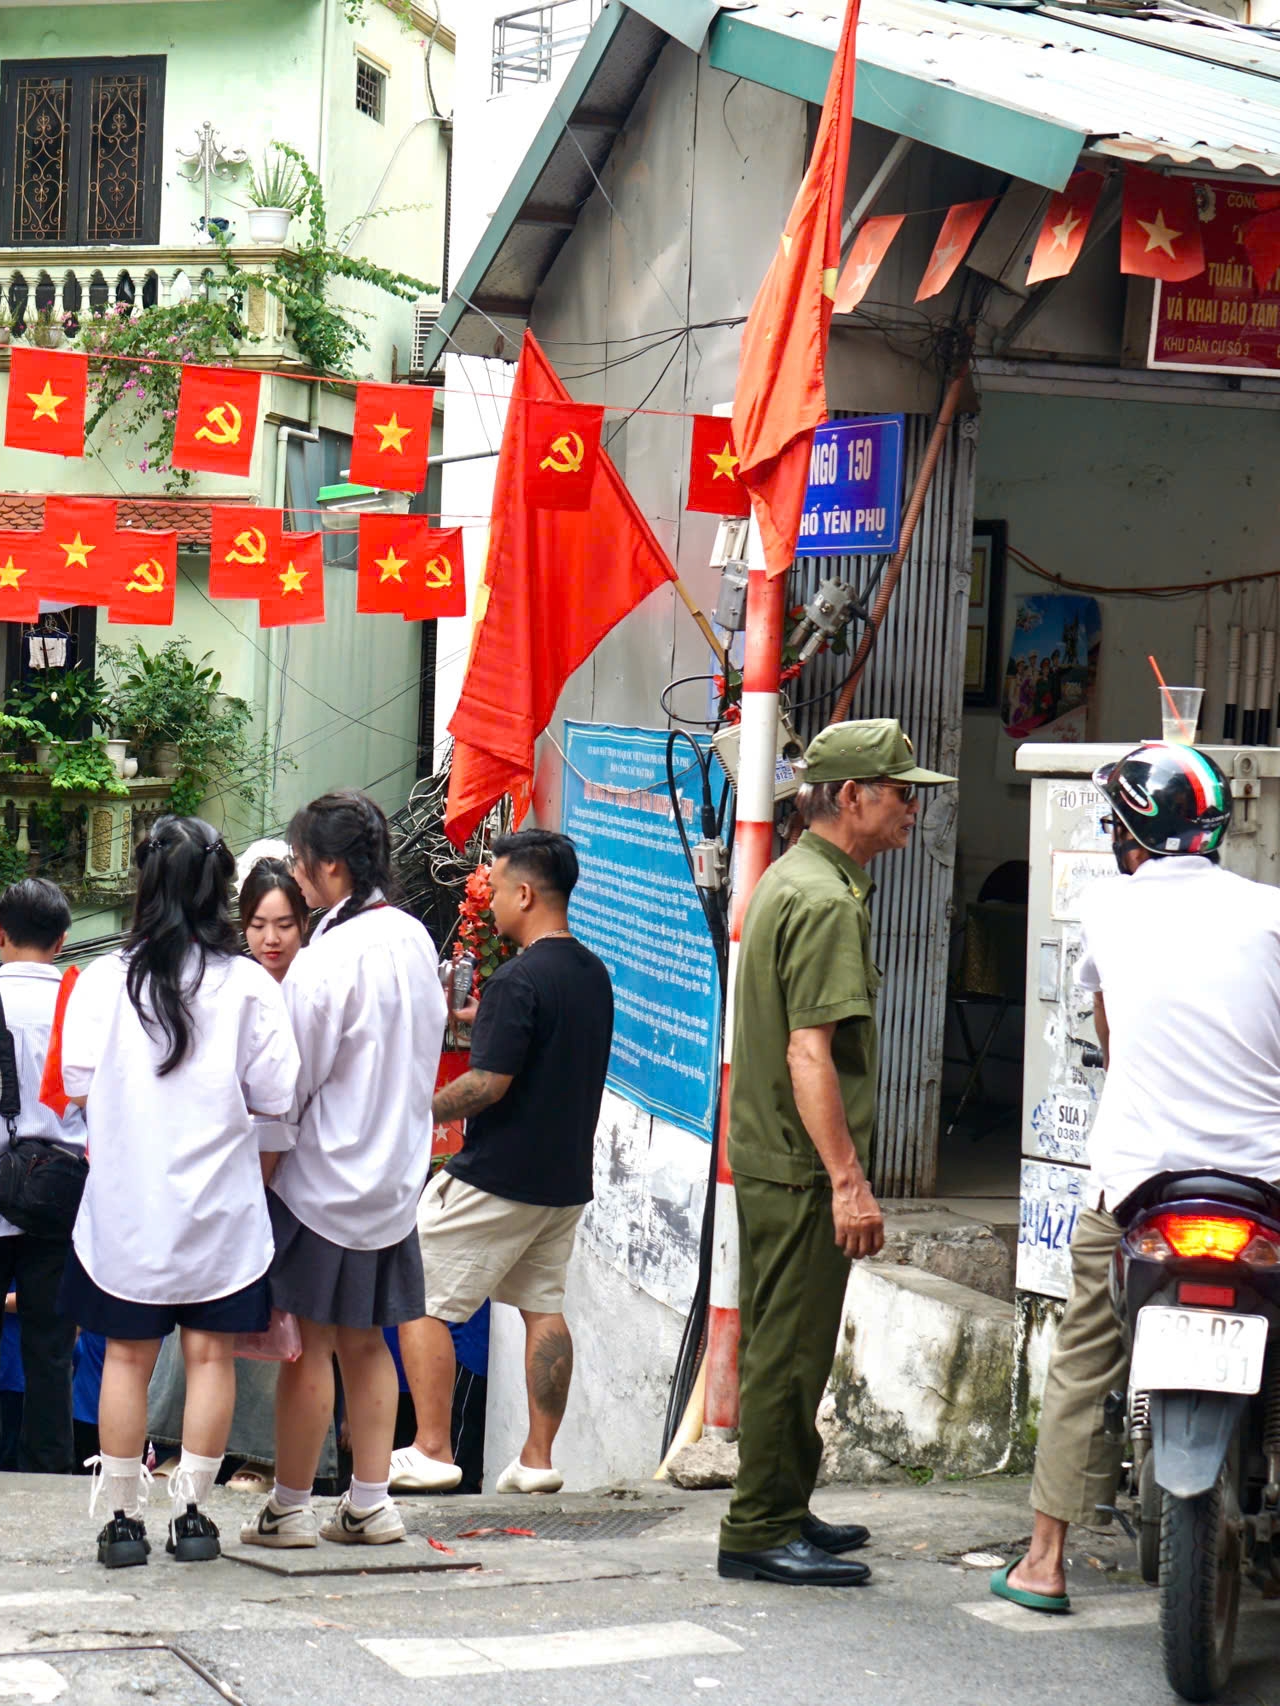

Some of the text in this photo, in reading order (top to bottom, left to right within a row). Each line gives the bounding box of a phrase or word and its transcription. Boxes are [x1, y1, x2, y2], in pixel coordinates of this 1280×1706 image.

[1186, 298, 1218, 324] KHAI
[1163, 337, 1185, 352] KHU
[1187, 336, 1209, 353] DÂN
[1243, 343, 1250, 357] 3
[809, 434, 872, 486] NGÕ 150
[800, 503, 886, 538] HỐ YÊN PHỤ
